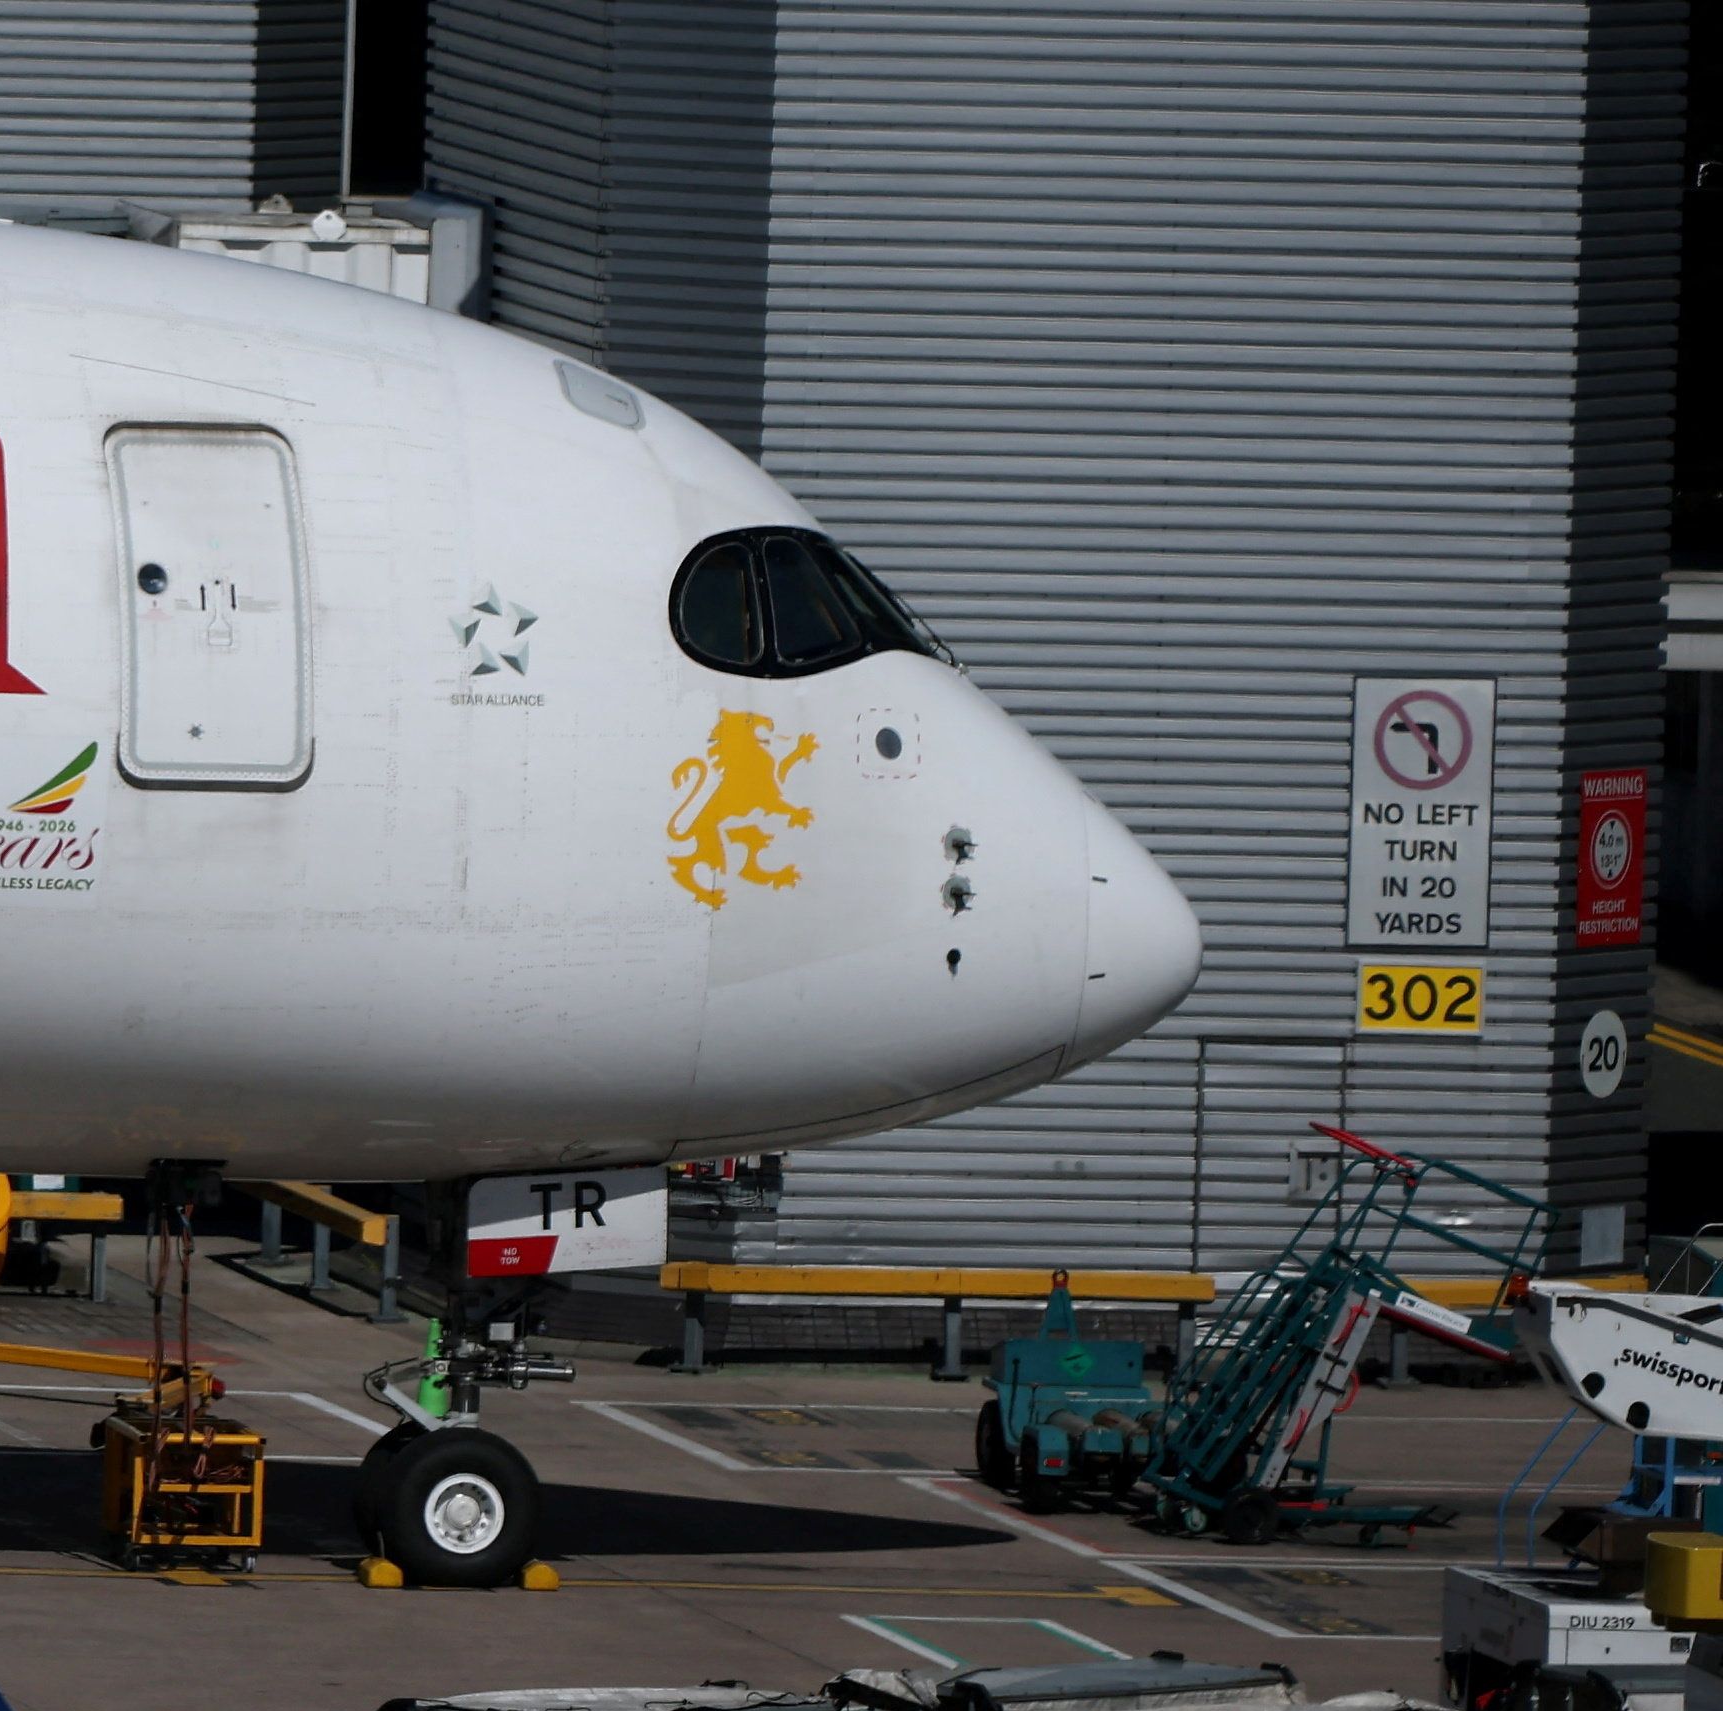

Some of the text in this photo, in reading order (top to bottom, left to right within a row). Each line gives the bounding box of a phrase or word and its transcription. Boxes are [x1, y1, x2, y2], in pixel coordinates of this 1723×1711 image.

[450, 693, 545, 706] STAR ALLIANCE
[1584, 776, 1643, 797] WARNING
[1363, 803, 1479, 826] NO LEFT
[38, 818, 76, 832] 2026
[1385, 840, 1457, 862] TURN
[37, 878, 95, 891] LEGACY
[1382, 877, 1456, 899] IN 20
[1592, 899, 1626, 915] HEIGHT
[1375, 913, 1462, 935] YARDS
[1579, 917, 1639, 935] RESTRICTION
[1364, 973, 1477, 1023] 302
[1588, 1036, 1620, 1073] 20
[500, 1256, 521, 1265] TOW
[502, 1247, 518, 1256] NO
[1570, 1616, 1635, 1629] DIU 2319
